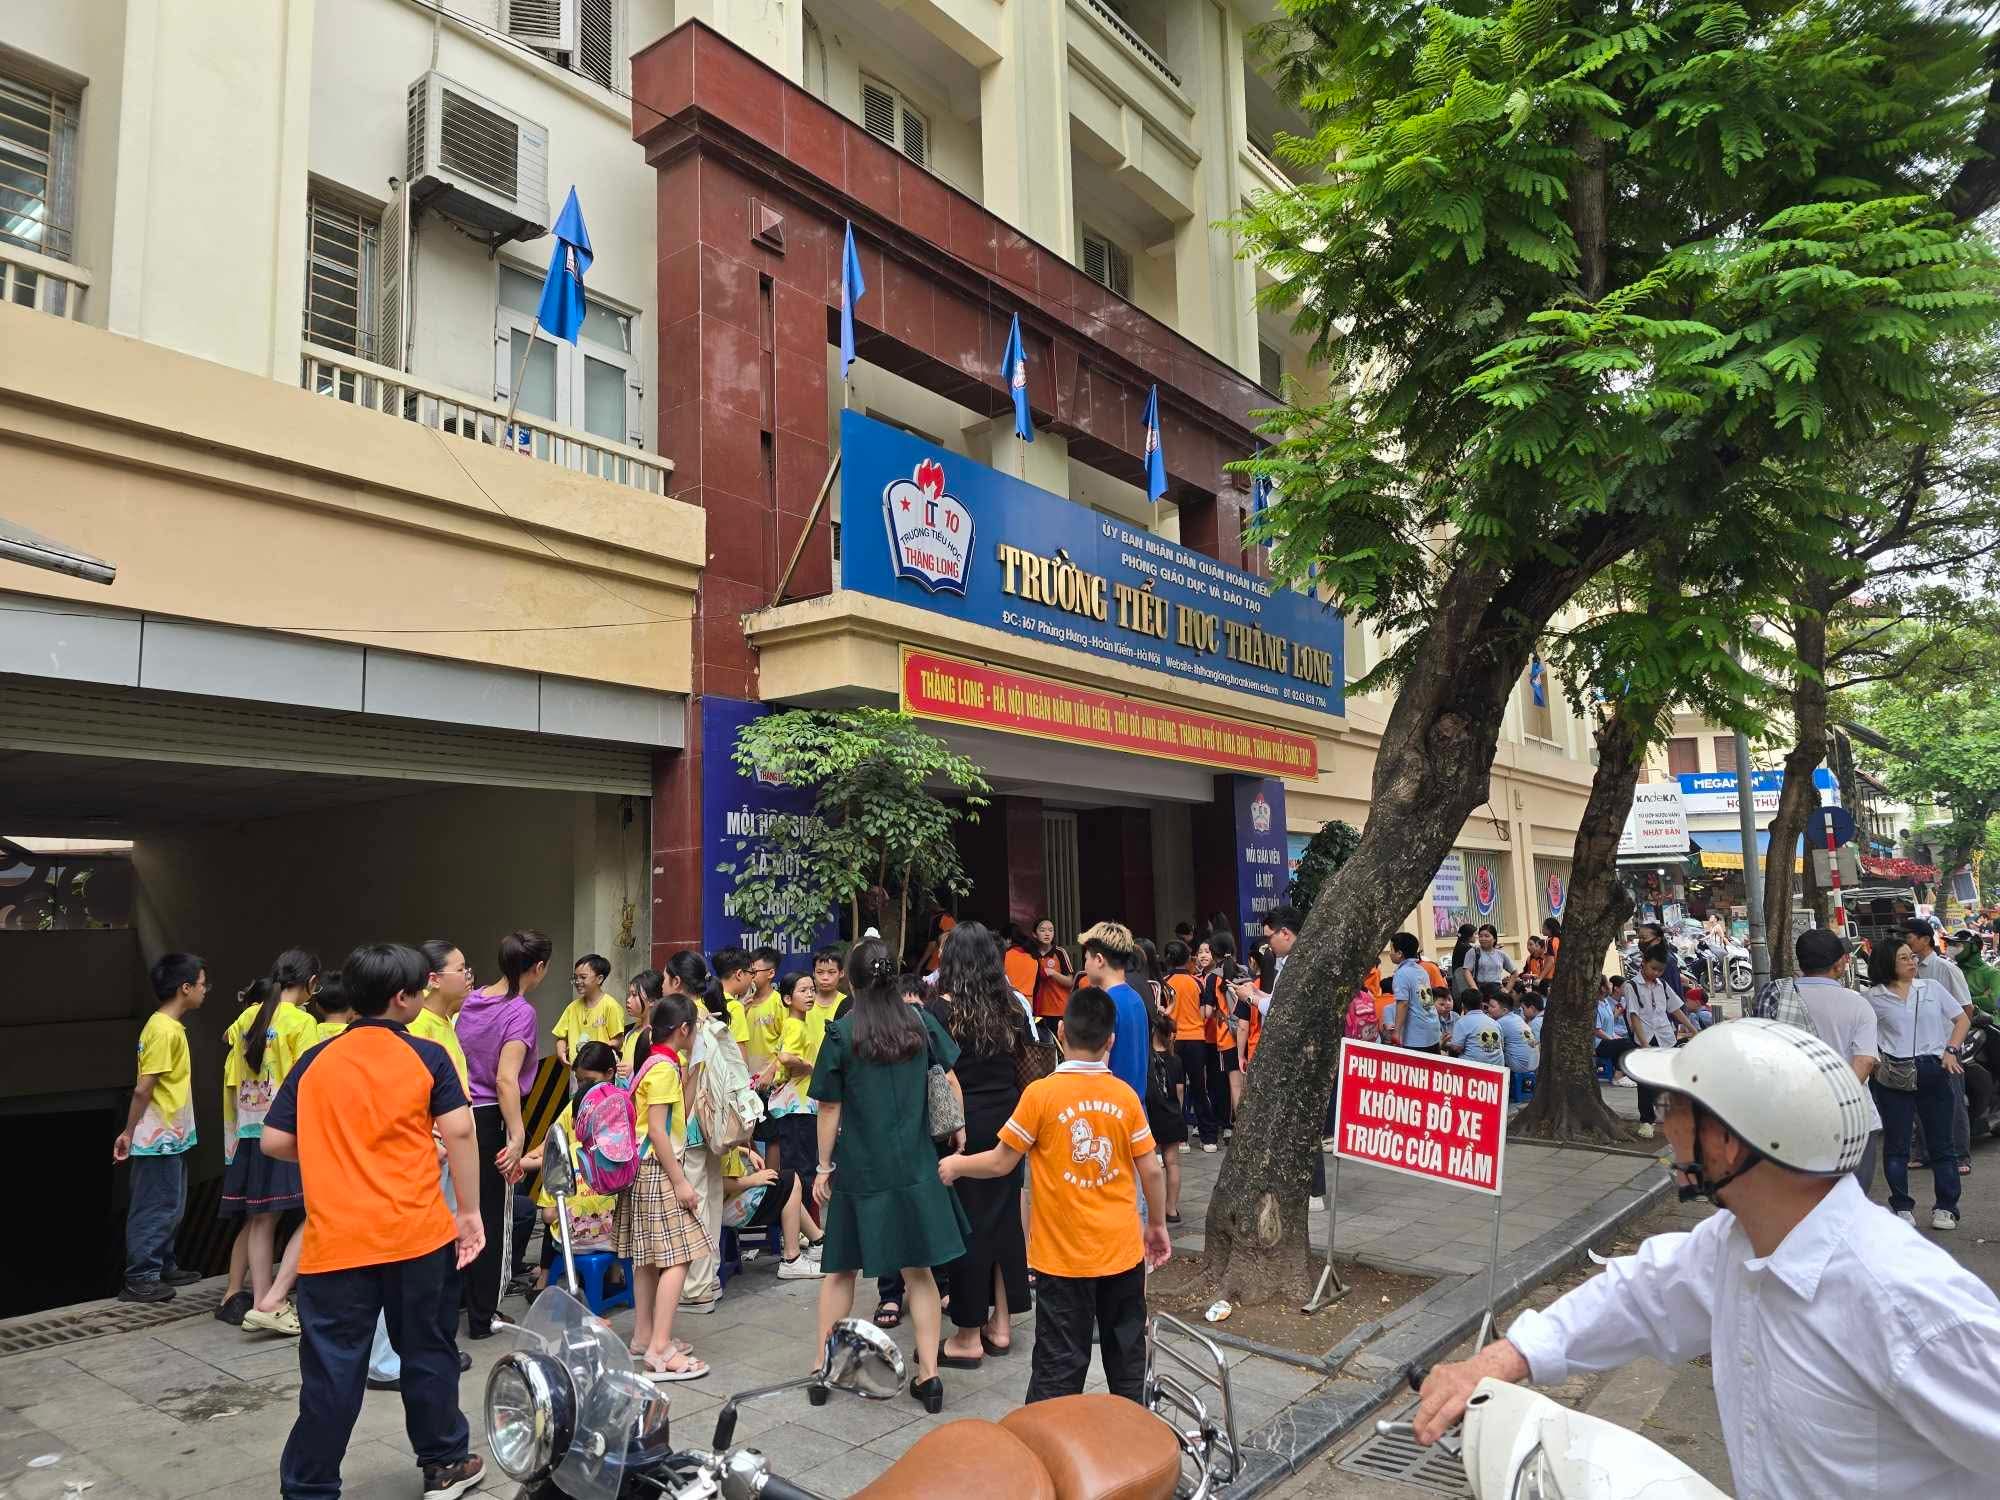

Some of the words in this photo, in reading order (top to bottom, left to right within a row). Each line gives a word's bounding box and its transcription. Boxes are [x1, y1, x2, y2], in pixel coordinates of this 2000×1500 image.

[945, 510, 960, 533] 10
[936, 557, 959, 578] LONG
[1103, 520, 1118, 539] ỦY
[1121, 531, 1143, 549] BAN
[1145, 540, 1174, 561] NHÂN
[1176, 552, 1196, 570] DÂN
[1198, 561, 1224, 581] QUẬN
[1226, 571, 1250, 589] HOÀN
[1121, 552, 1157, 576] PHÒNG
[1160, 568, 1185, 585] GIÁO
[1187, 577, 1206, 595] DỤC
[1209, 584, 1221, 599] VÀ
[1223, 590, 1242, 606] ĐÀO
[1244, 598, 1261, 616] TẠO
[998, 543, 1108, 622] TRƯỜNG
[1114, 577, 1168, 639] TIỂU
[1176, 604, 1220, 656] HỌC
[1224, 619, 1288, 674] THĂNG
[1292, 641, 1333, 687] LONG
[1038, 620, 1065, 641] Phùng
[1148, 650, 1160, 666] Nội
[920, 667, 955, 702] THĂNG
[958, 678, 984, 708] LONG
[992, 682, 1006, 713] HÀ
[1008, 685, 1024, 720] NỘI
[1026, 691, 1051, 721] NGÀN
[1052, 695, 1072, 725] NĂM
[1074, 700, 1091, 728] VĂN
[1092, 701, 1113, 735] HIẾN,
[1114, 706, 1128, 736] THỦ
[1129, 711, 1140, 738] ĐÔ
[1142, 717, 1157, 741] ANH
[1179, 720, 1201, 748] THÀNH
[1202, 722, 1215, 751] PHỐ
[1253, 735, 1272, 760] THÀNH
[1272, 737, 1284, 762] PHỐ
[1284, 741, 1299, 765] SÁNG
[1694, 777, 1759, 791] MEGAMN
[752, 848, 768, 875] LÀ
[1257, 847, 1268, 864] GIÁO
[1348, 1055, 1377, 1083] PHỤ
[1380, 1061, 1429, 1089] HUYNH
[1433, 1069, 1463, 1097] ĐÓN
[1467, 1078, 1498, 1105] CON
[1078, 1100, 1123, 1120] ALWAYS
[1359, 1089, 1422, 1128] KHÔNG
[1426, 1096, 1453, 1134] ĐỖ
[1457, 1109, 1482, 1141] XE
[1346, 1123, 1403, 1162] TRƯỚC
[1405, 1130, 1442, 1172] CỬA
[1448, 1142, 1493, 1184] HẦM
